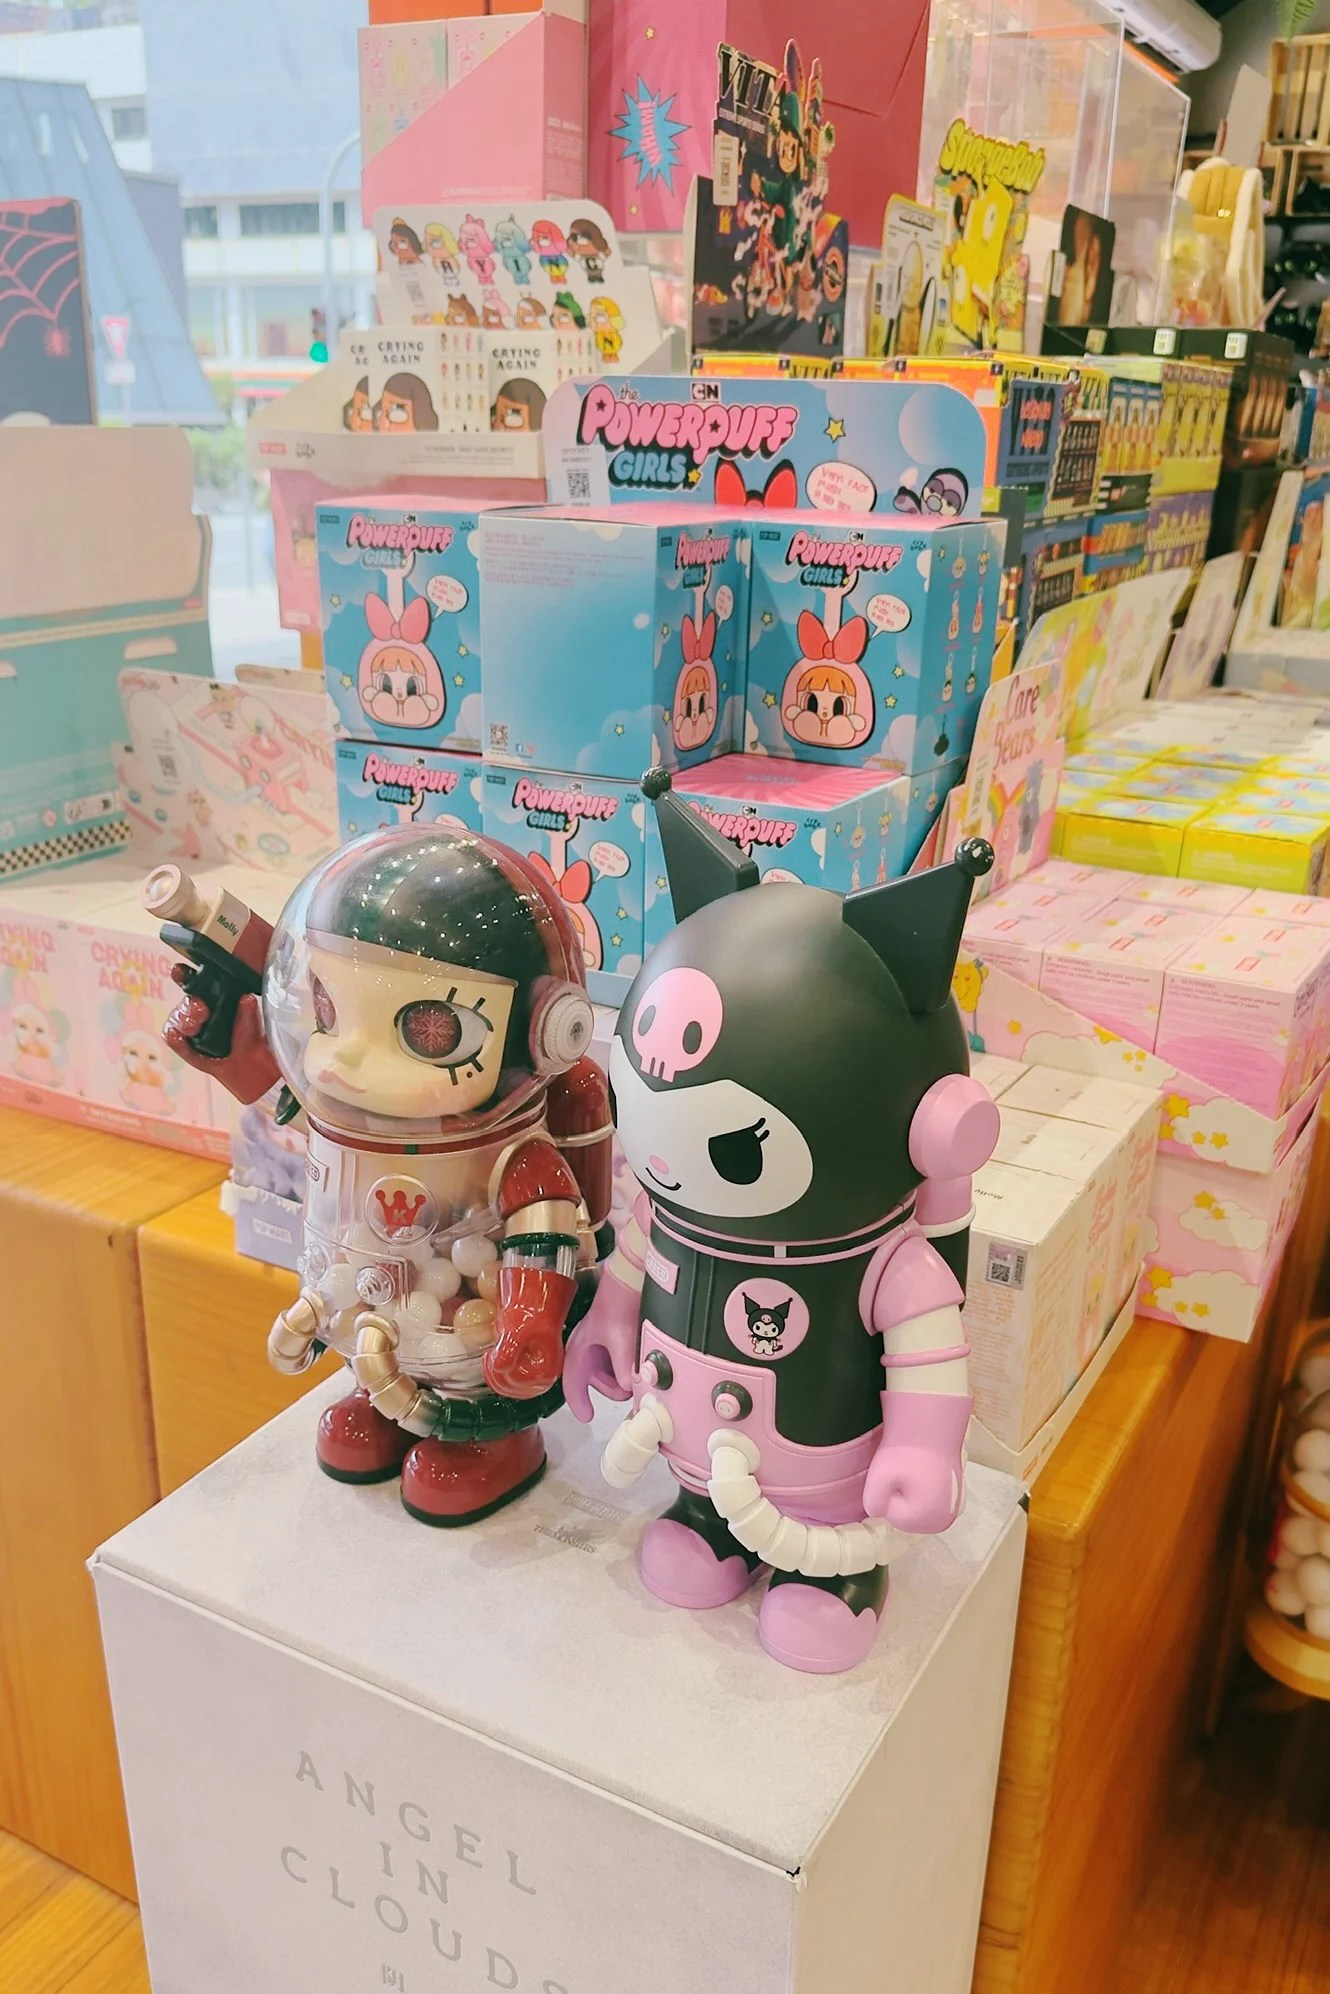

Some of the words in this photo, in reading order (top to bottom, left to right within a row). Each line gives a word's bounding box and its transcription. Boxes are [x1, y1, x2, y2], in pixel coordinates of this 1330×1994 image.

[637, 101, 661, 167] WHAM!
[691, 383, 720, 400] CN
[577, 383, 798, 465] POWERPUFF
[611, 450, 688, 487] GIRLS
[346, 512, 454, 556] POWERPUFF
[675, 531, 729, 570] POWERPUFF
[785, 530, 904, 575] POWERPUFF
[803, 566, 844, 587] GIRLS
[1005, 675, 1040, 725] Care
[363, 752, 458, 795] POWERPUFF
[512, 777, 619, 823] POWERPUFF
[528, 810, 566, 831] GIRLS
[217, 914, 239, 937] Molly
[295, 1750, 538, 1896] ANGEL
[379, 1841, 449, 1905] IN
